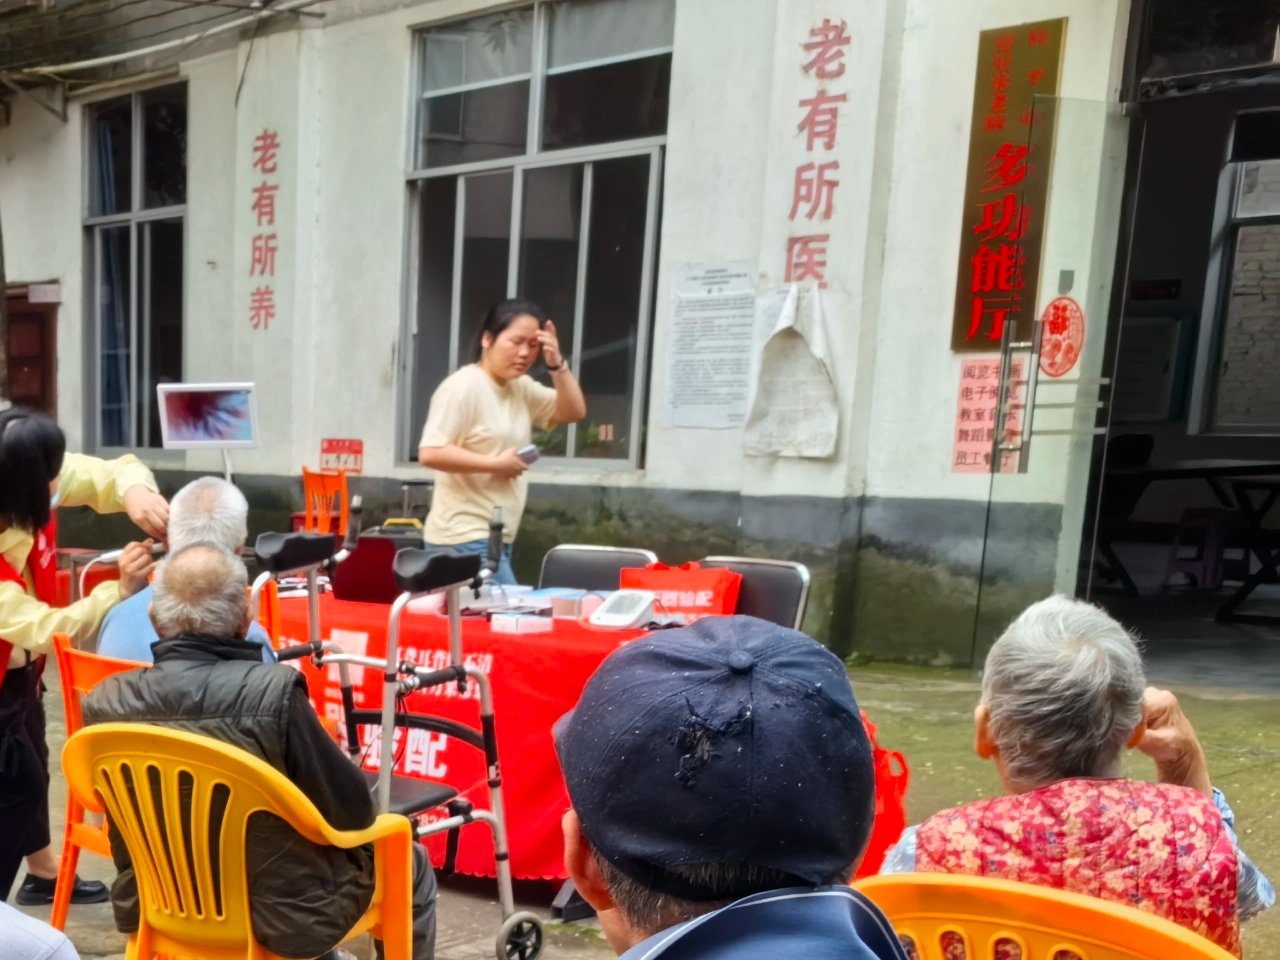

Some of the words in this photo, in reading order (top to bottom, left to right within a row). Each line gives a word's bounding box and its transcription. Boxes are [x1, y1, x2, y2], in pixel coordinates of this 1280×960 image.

[249, 128, 281, 330] 老有所养
[784, 18, 852, 290] 老有所医
[968, 143, 1032, 341] 多功能厅
